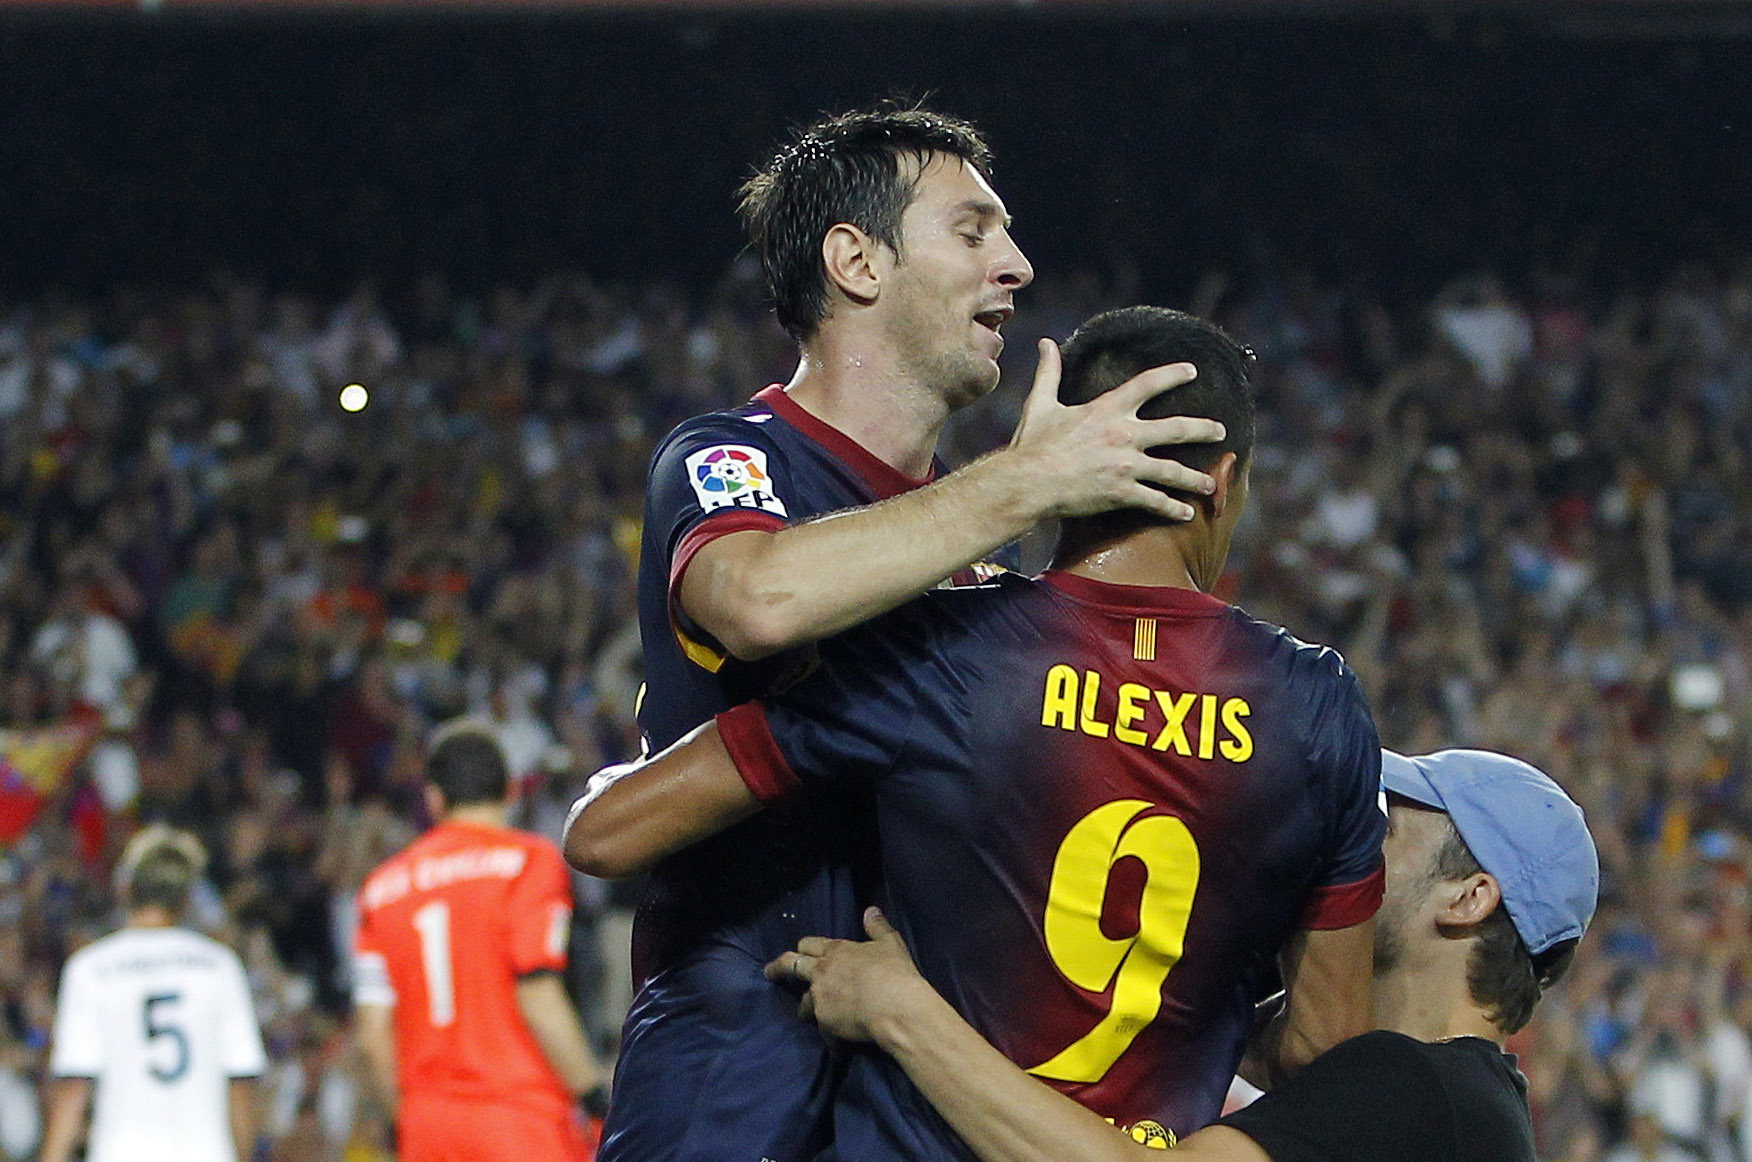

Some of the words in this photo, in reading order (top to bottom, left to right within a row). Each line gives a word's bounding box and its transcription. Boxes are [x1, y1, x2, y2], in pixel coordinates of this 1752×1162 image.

[1041, 664, 1254, 763] ALEXIS
[414, 901, 455, 1027] 1
[1024, 799, 1201, 1083] 9
[144, 992, 190, 1084] 5
